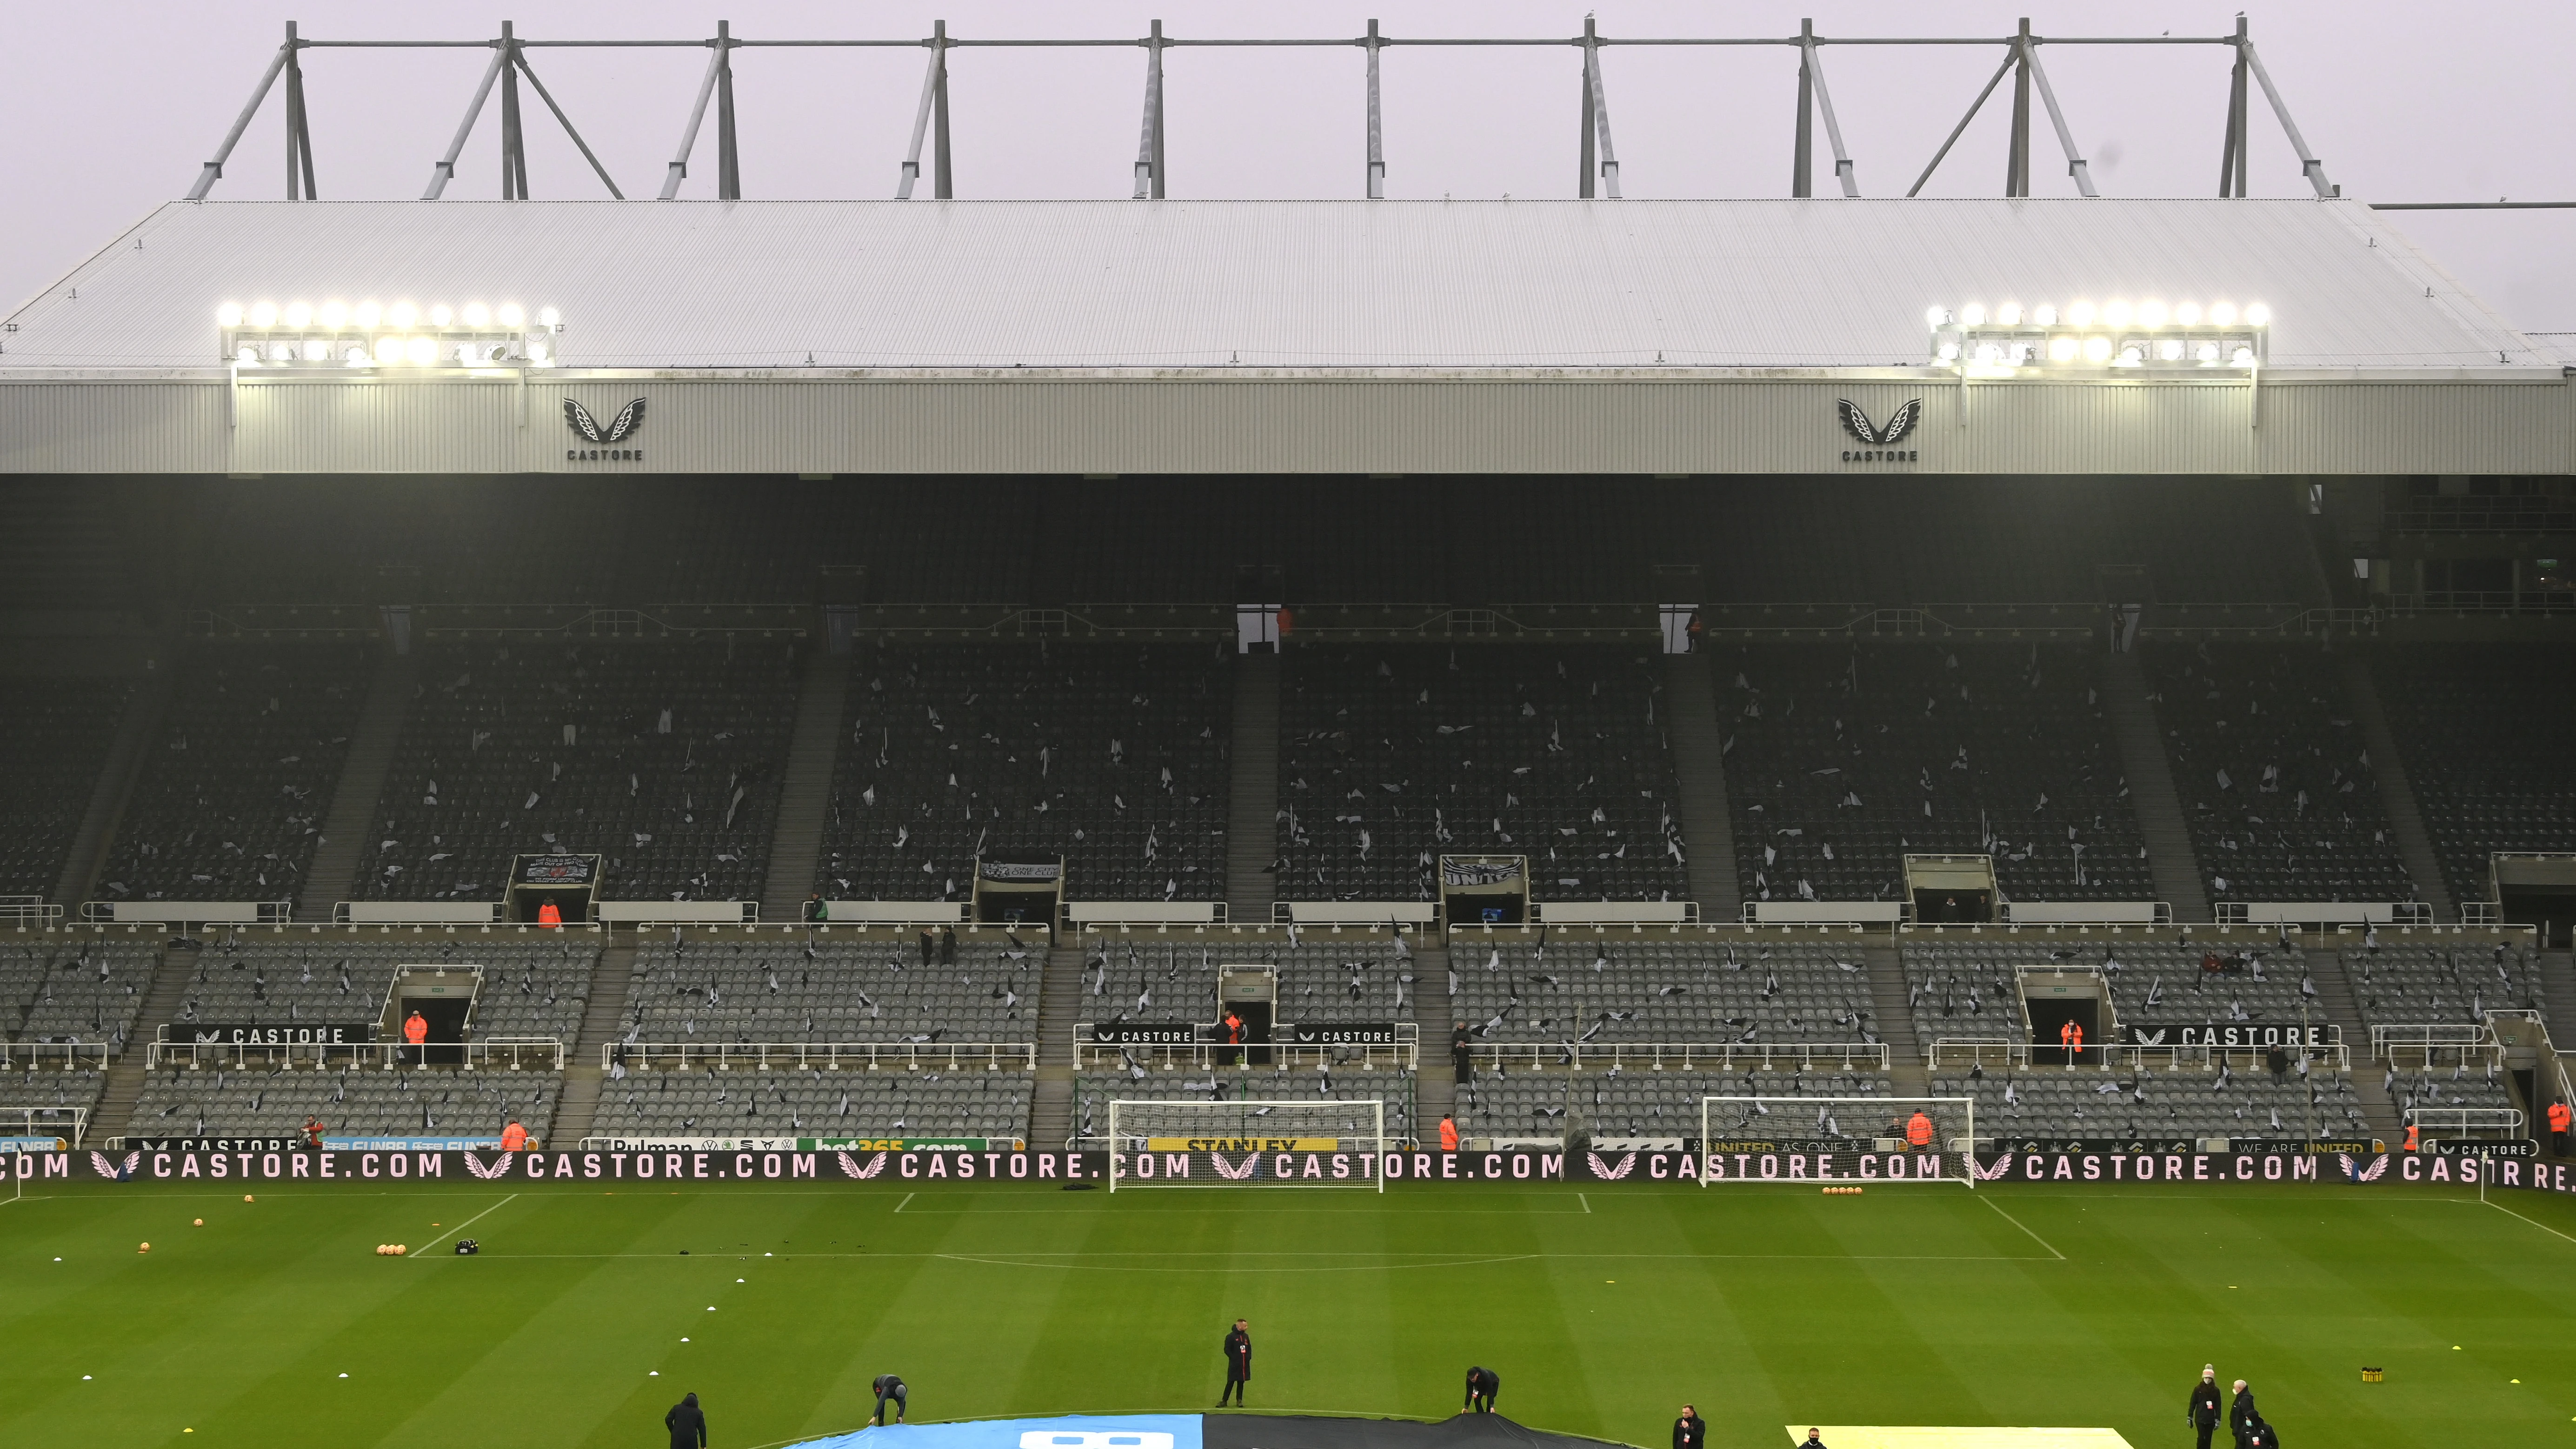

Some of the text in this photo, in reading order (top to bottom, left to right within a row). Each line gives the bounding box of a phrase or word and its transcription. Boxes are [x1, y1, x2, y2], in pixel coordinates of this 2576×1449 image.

[567, 449, 642, 462] CASTORE
[1842, 450, 1917, 462] CASTORE
[233, 1028, 343, 1044] CASTORE
[1122, 1031, 1191, 1042] CASTORE
[1322, 1031, 1391, 1042] CASTORE
[2182, 1026, 2320, 1045] CASTORE
[182, 1139, 297, 1150] CASTORE
[1782, 1142, 1800, 1151] AS
[1806, 1142, 1843, 1151] ONE
[2238, 1143, 2364, 1152] WE ARE UNITED
[154, 1153, 441, 1177] CASTORE.COM
[527, 1154, 815, 1177] CASTORE.COM
[901, 1154, 1189, 1178] CASTORE.COM
[1275, 1154, 1565, 1178] CASTORE.COM
[1651, 1154, 1940, 1180] CASTORE.COM
[2026, 1155, 2316, 1180] CASTORE.COM
